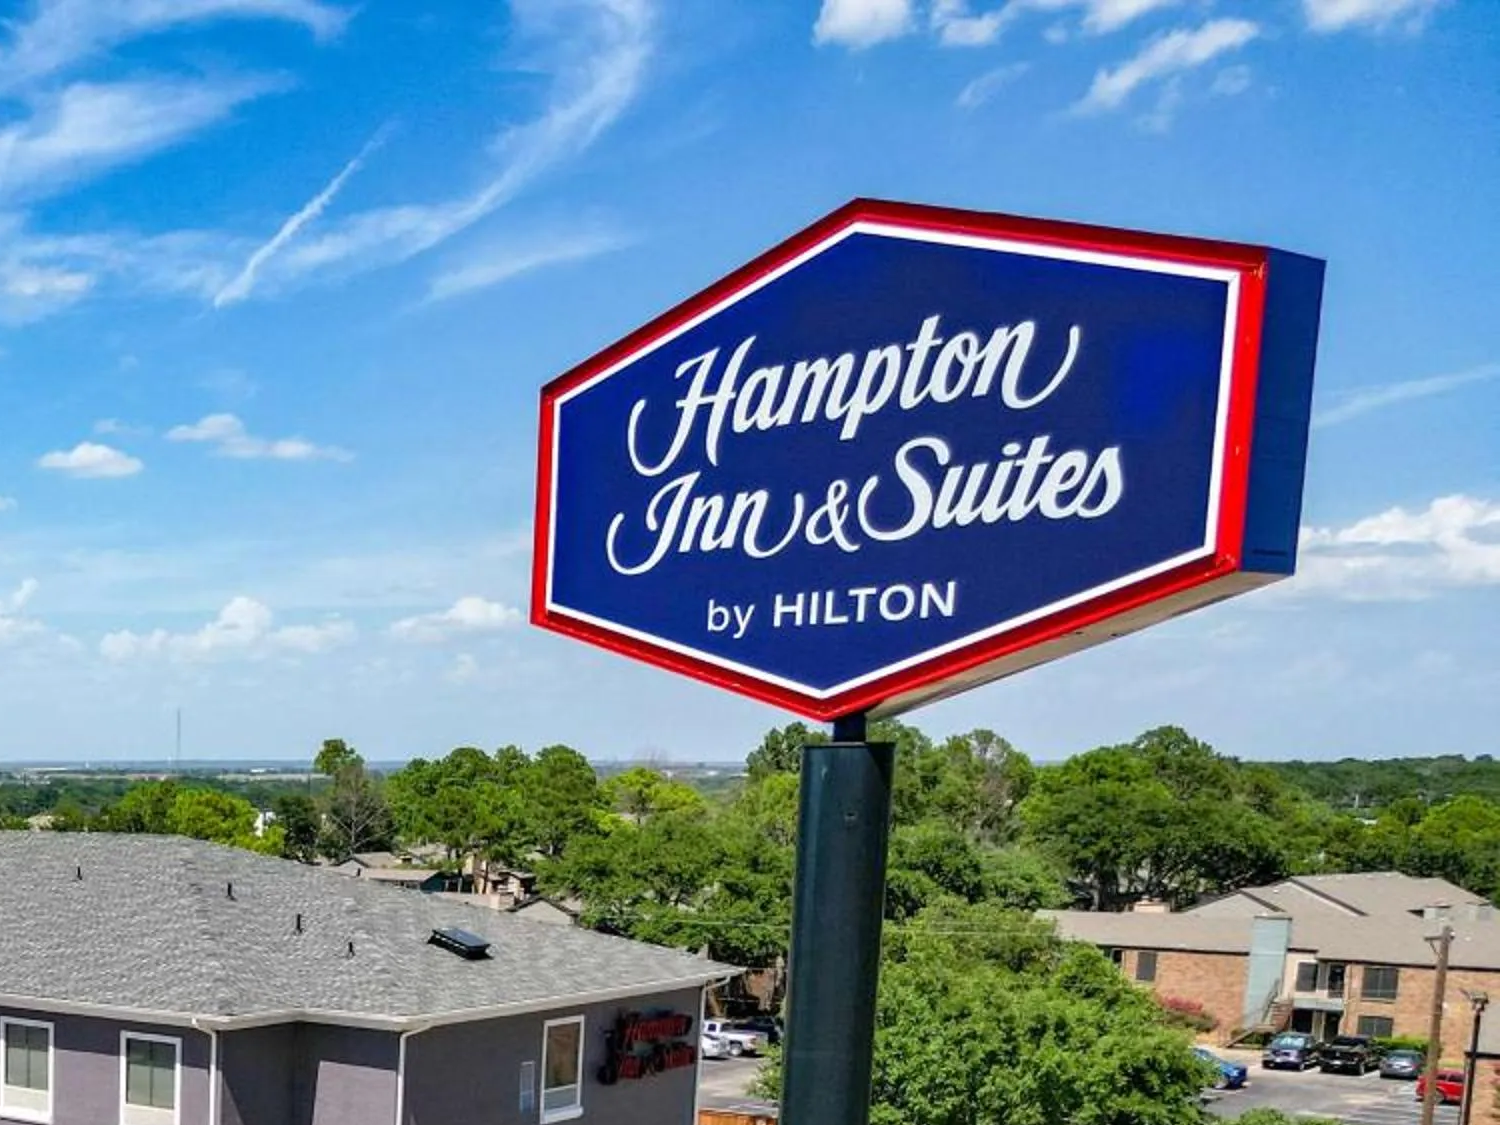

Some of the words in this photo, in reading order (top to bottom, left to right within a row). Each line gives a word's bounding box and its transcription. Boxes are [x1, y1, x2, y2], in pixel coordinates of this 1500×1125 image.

[628, 315, 1080, 476] Hampton
[607, 471, 804, 574] Inn
[806, 480, 860, 552] &
[858, 435, 1123, 540] Suites
[708, 600, 754, 638] by
[774, 581, 956, 627] HILTON
